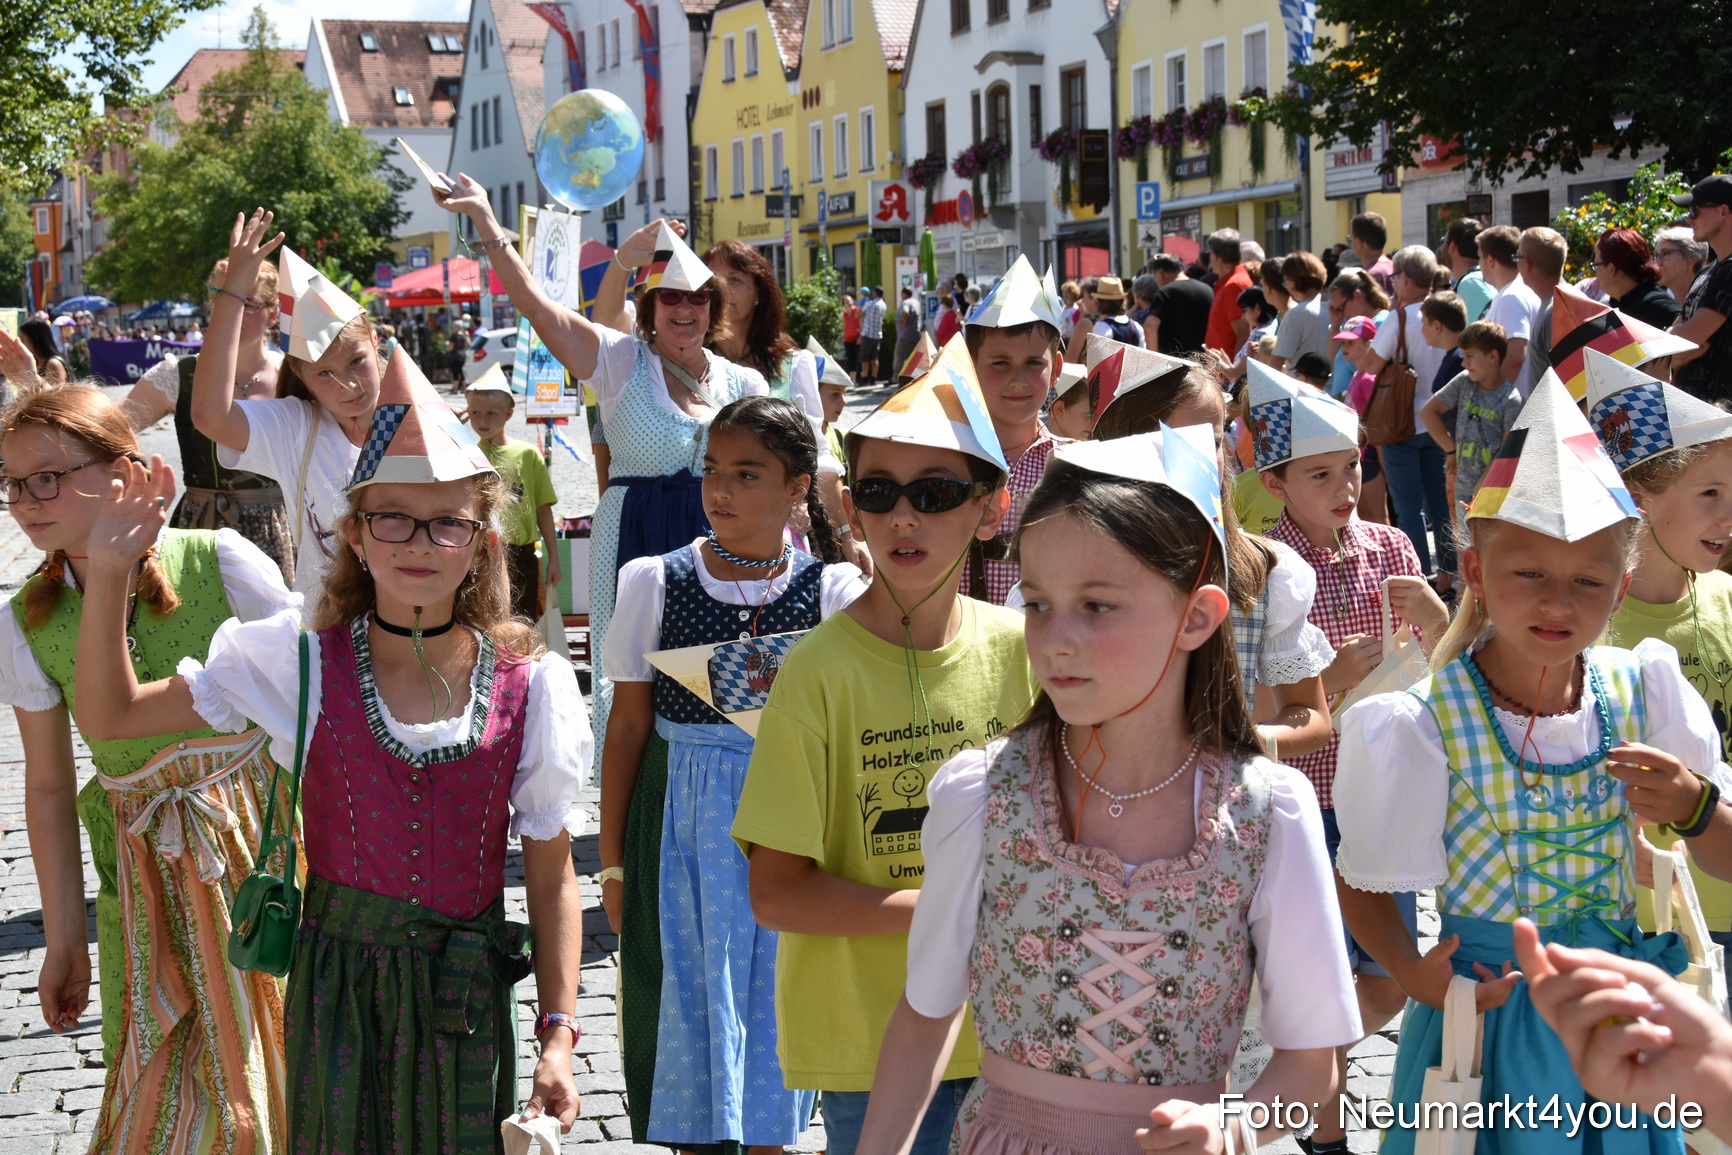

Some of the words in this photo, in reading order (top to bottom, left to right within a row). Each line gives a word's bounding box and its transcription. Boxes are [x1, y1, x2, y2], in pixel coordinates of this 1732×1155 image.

[736, 104, 761, 130] HOTEL
[1141, 187, 1155, 216] P
[738, 221, 771, 238] Restaurant
[931, 301, 938, 313] P
[537, 385, 559, 400] School
[861, 717, 964, 745] Grundschule
[863, 746, 944, 771] Holzheim
